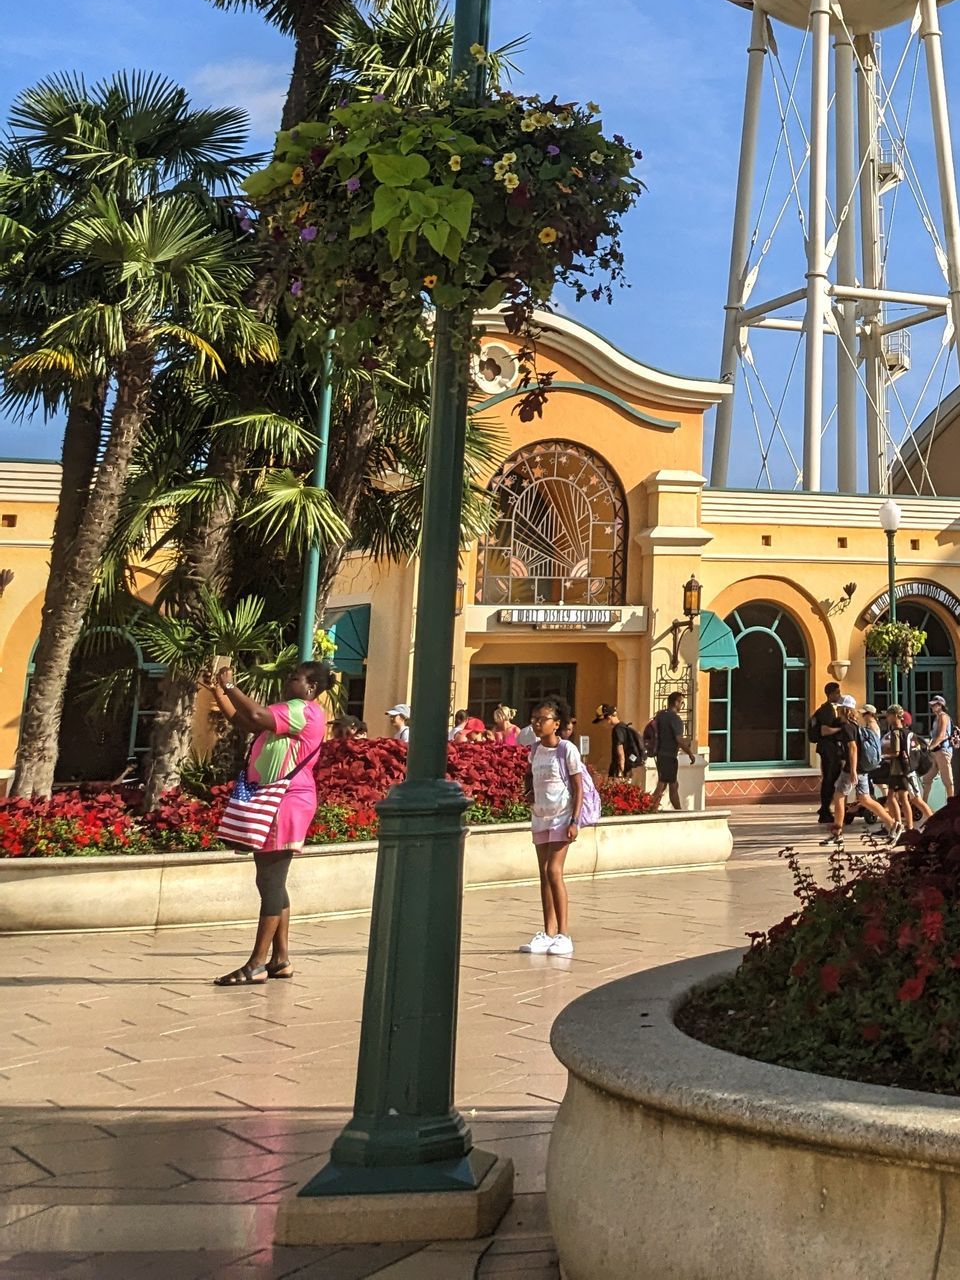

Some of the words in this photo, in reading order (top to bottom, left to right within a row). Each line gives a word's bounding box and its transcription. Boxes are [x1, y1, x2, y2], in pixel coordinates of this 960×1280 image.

[518, 609, 539, 622] WALT
[544, 609, 571, 622] DISNEY
[575, 609, 607, 622] STUDIOS
